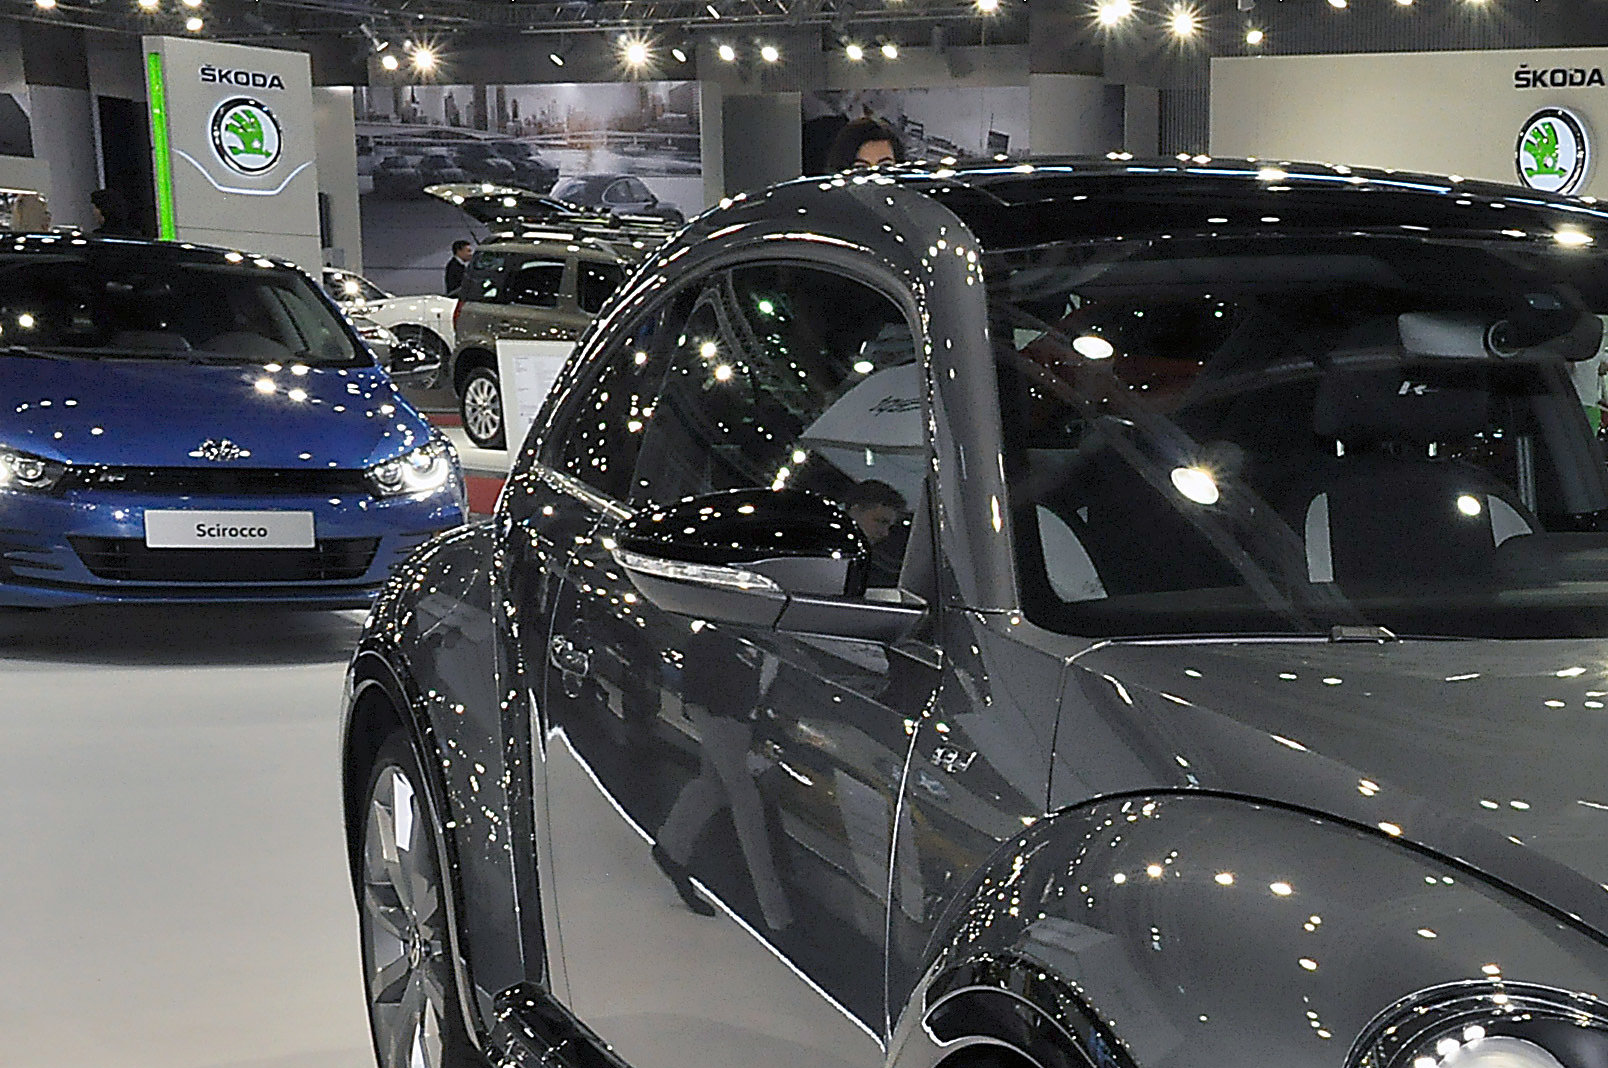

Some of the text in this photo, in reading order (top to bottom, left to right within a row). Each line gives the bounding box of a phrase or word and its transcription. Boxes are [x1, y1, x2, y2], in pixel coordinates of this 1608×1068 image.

[200, 63, 285, 90] ŠKODA
[1514, 64, 1605, 88] ŠKODA
[196, 523, 268, 538] Scirocco
